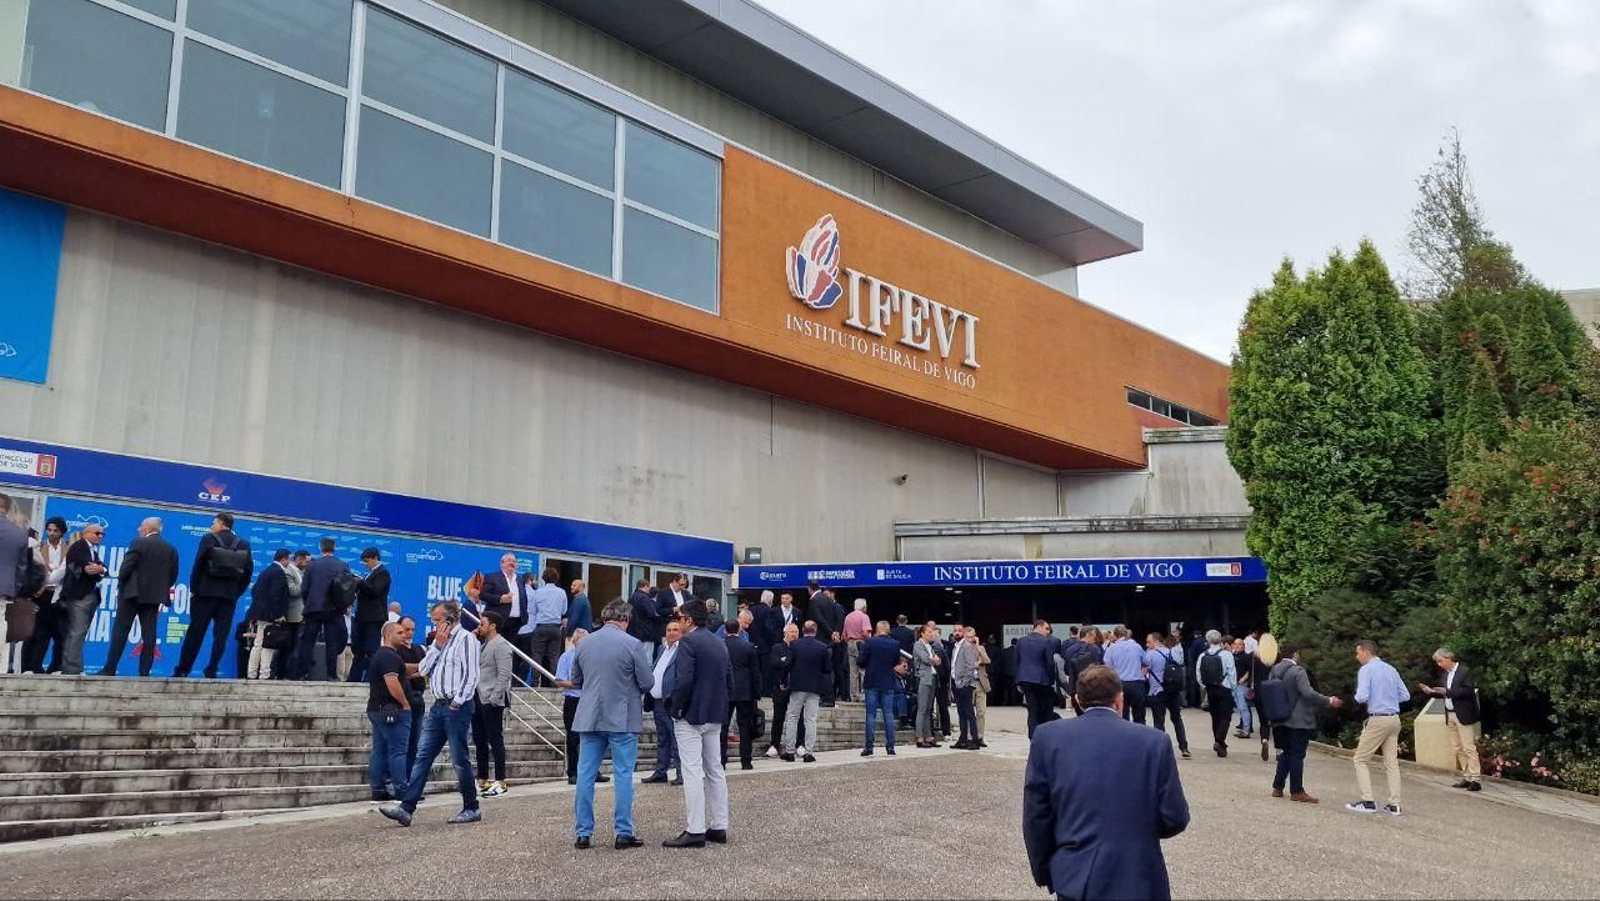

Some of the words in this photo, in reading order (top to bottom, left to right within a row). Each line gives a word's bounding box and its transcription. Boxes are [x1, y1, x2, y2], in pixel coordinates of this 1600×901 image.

[844, 267, 981, 369] IFEVI
[786, 313, 868, 356] INSTITUTO
[872, 341, 921, 372] FEIRAL
[924, 360, 941, 379] DE
[944, 368, 976, 390] VIGO
[198, 492, 231, 502] CEP
[933, 565, 1029, 581] INSTITUTO
[1033, 564, 1100, 580] FEIRAL
[1104, 563, 1131, 578] DE
[1134, 562, 1184, 578] VIGO
[427, 575, 463, 602] BLUE
